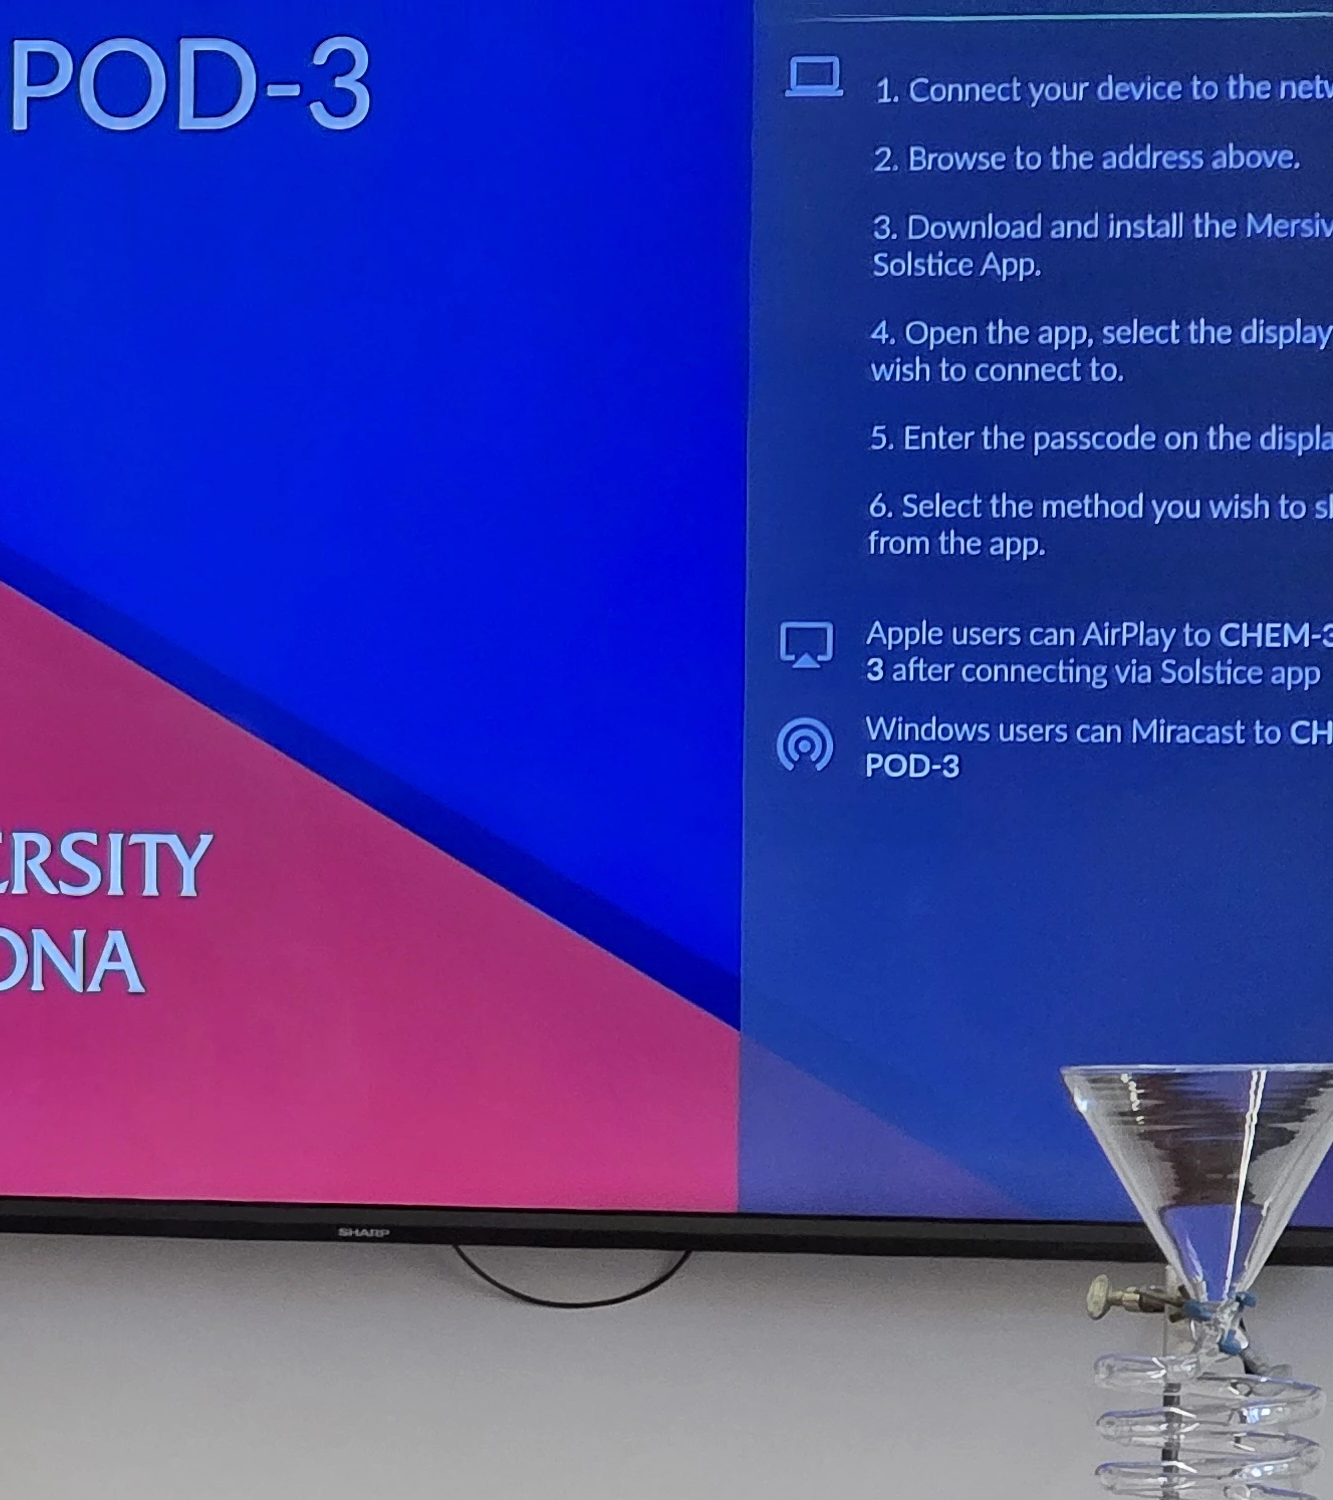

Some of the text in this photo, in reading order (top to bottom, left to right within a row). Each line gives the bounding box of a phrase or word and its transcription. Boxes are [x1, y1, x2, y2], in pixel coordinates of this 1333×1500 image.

[877, 77, 899, 103] 1.
[909, 76, 1022, 103] Connect
[1028, 81, 1090, 108] your
[1097, 74, 1183, 101] device
[1191, 74, 1219, 100] to
[1227, 73, 1272, 100] the
[873, 142, 1300, 172] 2. Browse to the address above.
[873, 211, 1333, 240] 3. Download and install the Mersiv
[873, 250, 1041, 282] Solstice App.
[870, 317, 1333, 351] 4. Open the app, select the display
[870, 355, 1124, 382] wish to connect to.
[870, 425, 894, 450] 5.
[904, 425, 976, 450] Enter
[981, 424, 1026, 450] the
[1033, 423, 1156, 456] passcode
[1164, 431, 1198, 450] on
[1206, 423, 1252, 451] the
[869, 492, 893, 518] 6.
[902, 492, 983, 518] Select
[989, 492, 1034, 519] the
[1042, 491, 1144, 519] method
[1151, 499, 1201, 525] you
[1209, 492, 1270, 519] wish
[1279, 494, 1307, 520] to
[868, 528, 1046, 561] from the app.
[865, 619, 1333, 653] Apple users can AirPlay to CHEM-3
[866, 655, 1321, 691] 3 after connecting via Solstice app
[865, 715, 1333, 745] Windows users can Miracast to CH
[866, 752, 960, 778] POD-3
[338, 1228, 390, 1238] SHARP
